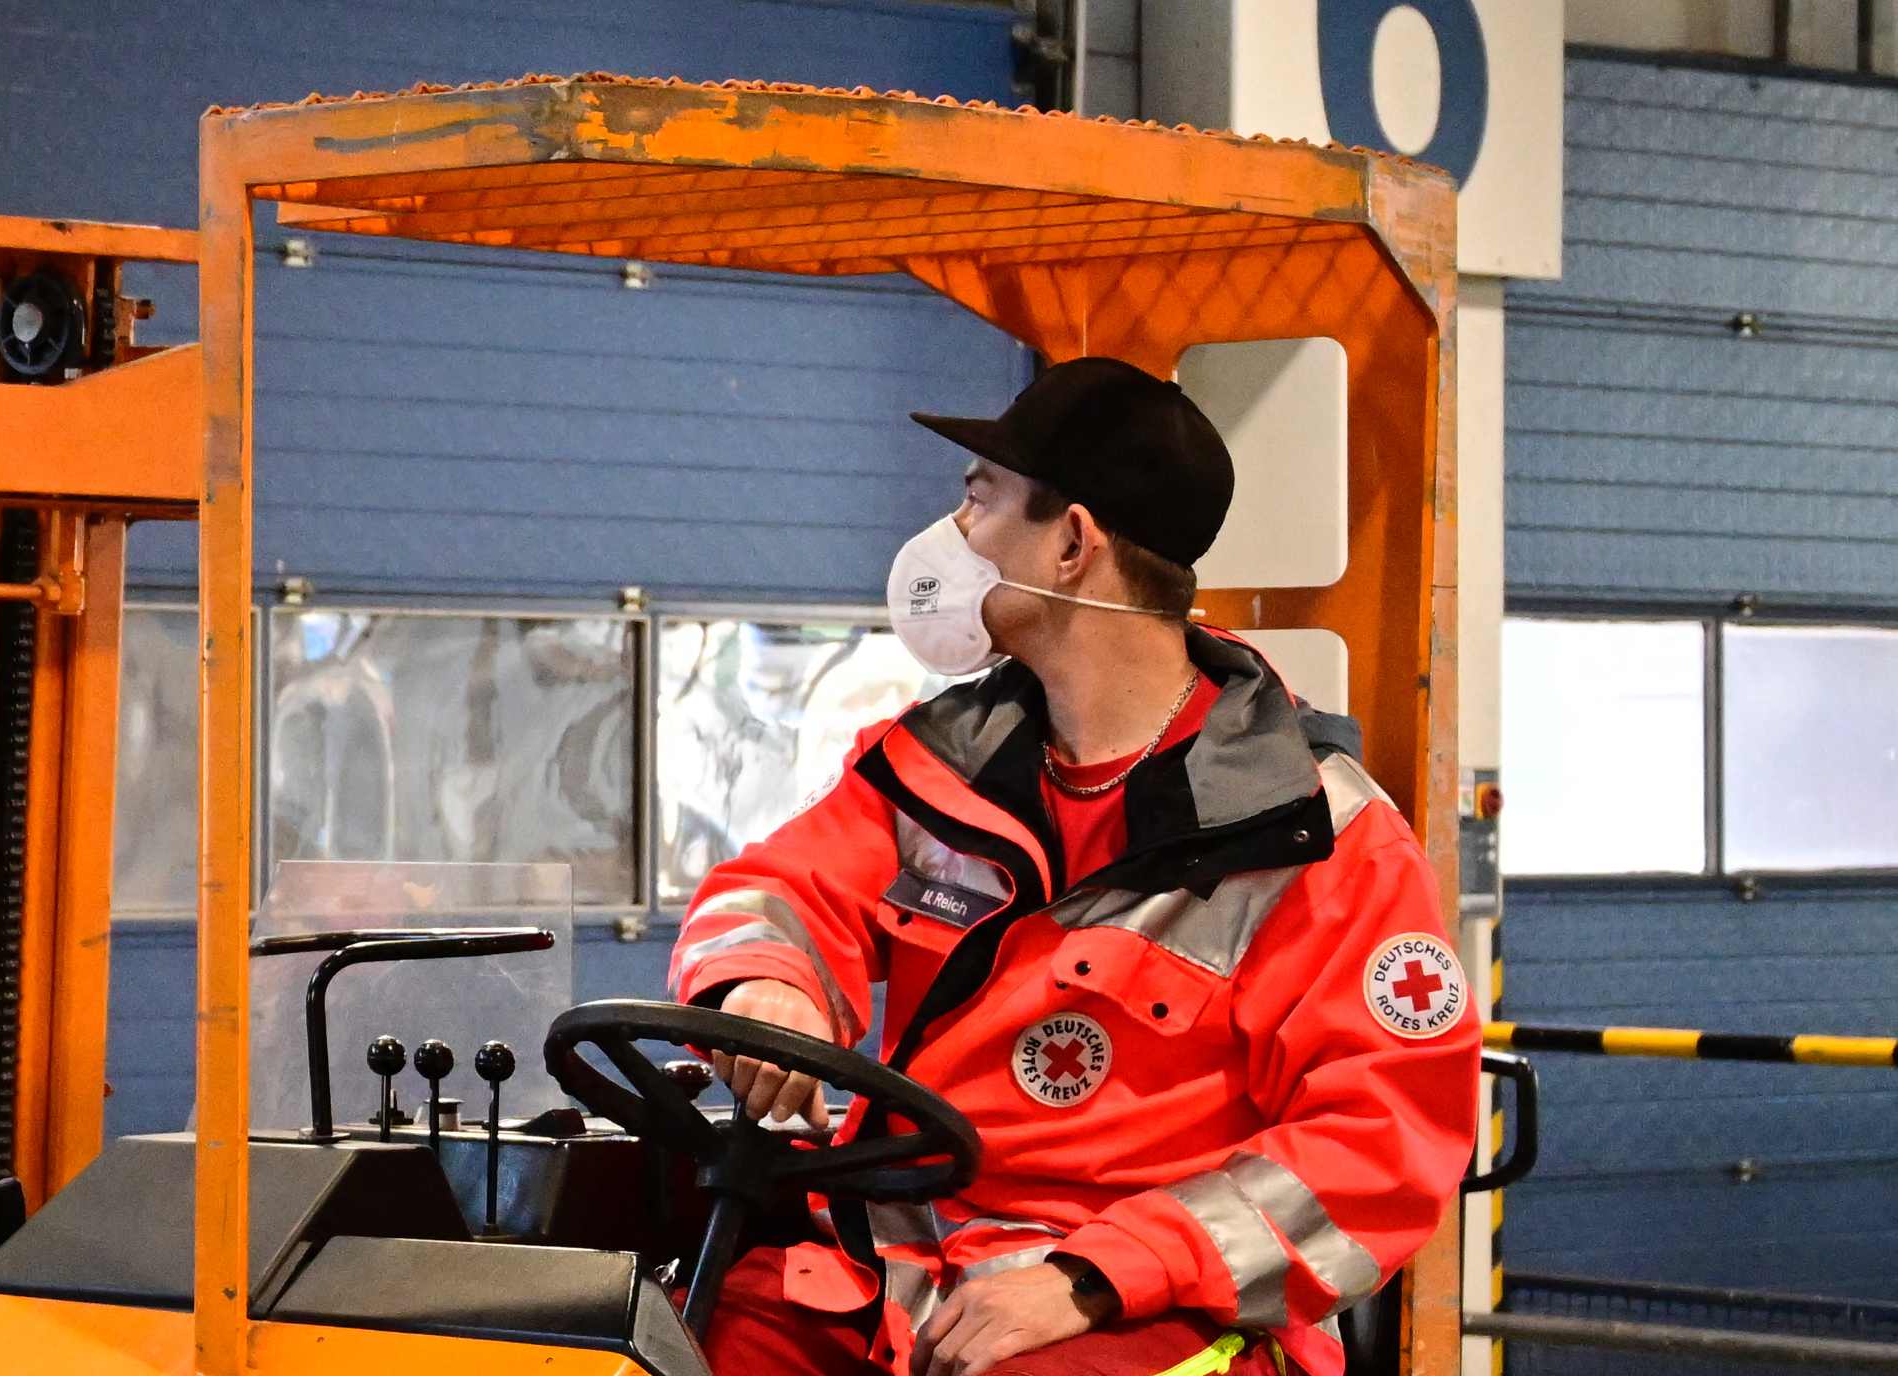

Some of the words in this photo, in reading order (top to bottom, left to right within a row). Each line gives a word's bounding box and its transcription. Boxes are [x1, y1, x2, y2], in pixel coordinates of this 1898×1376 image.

[914, 581, 936, 593] JSP
[933, 892, 967, 916] Reich
[1374, 941, 1452, 982] DEUTSCHES
[1376, 995, 1420, 1030] ROTES
[1427, 983, 1459, 1028] KREUZ
[1043, 1019, 1104, 1072] DEUTSCHES
[1022, 1036, 1041, 1083] ROTES
[1039, 1076, 1092, 1100] KREUZ
